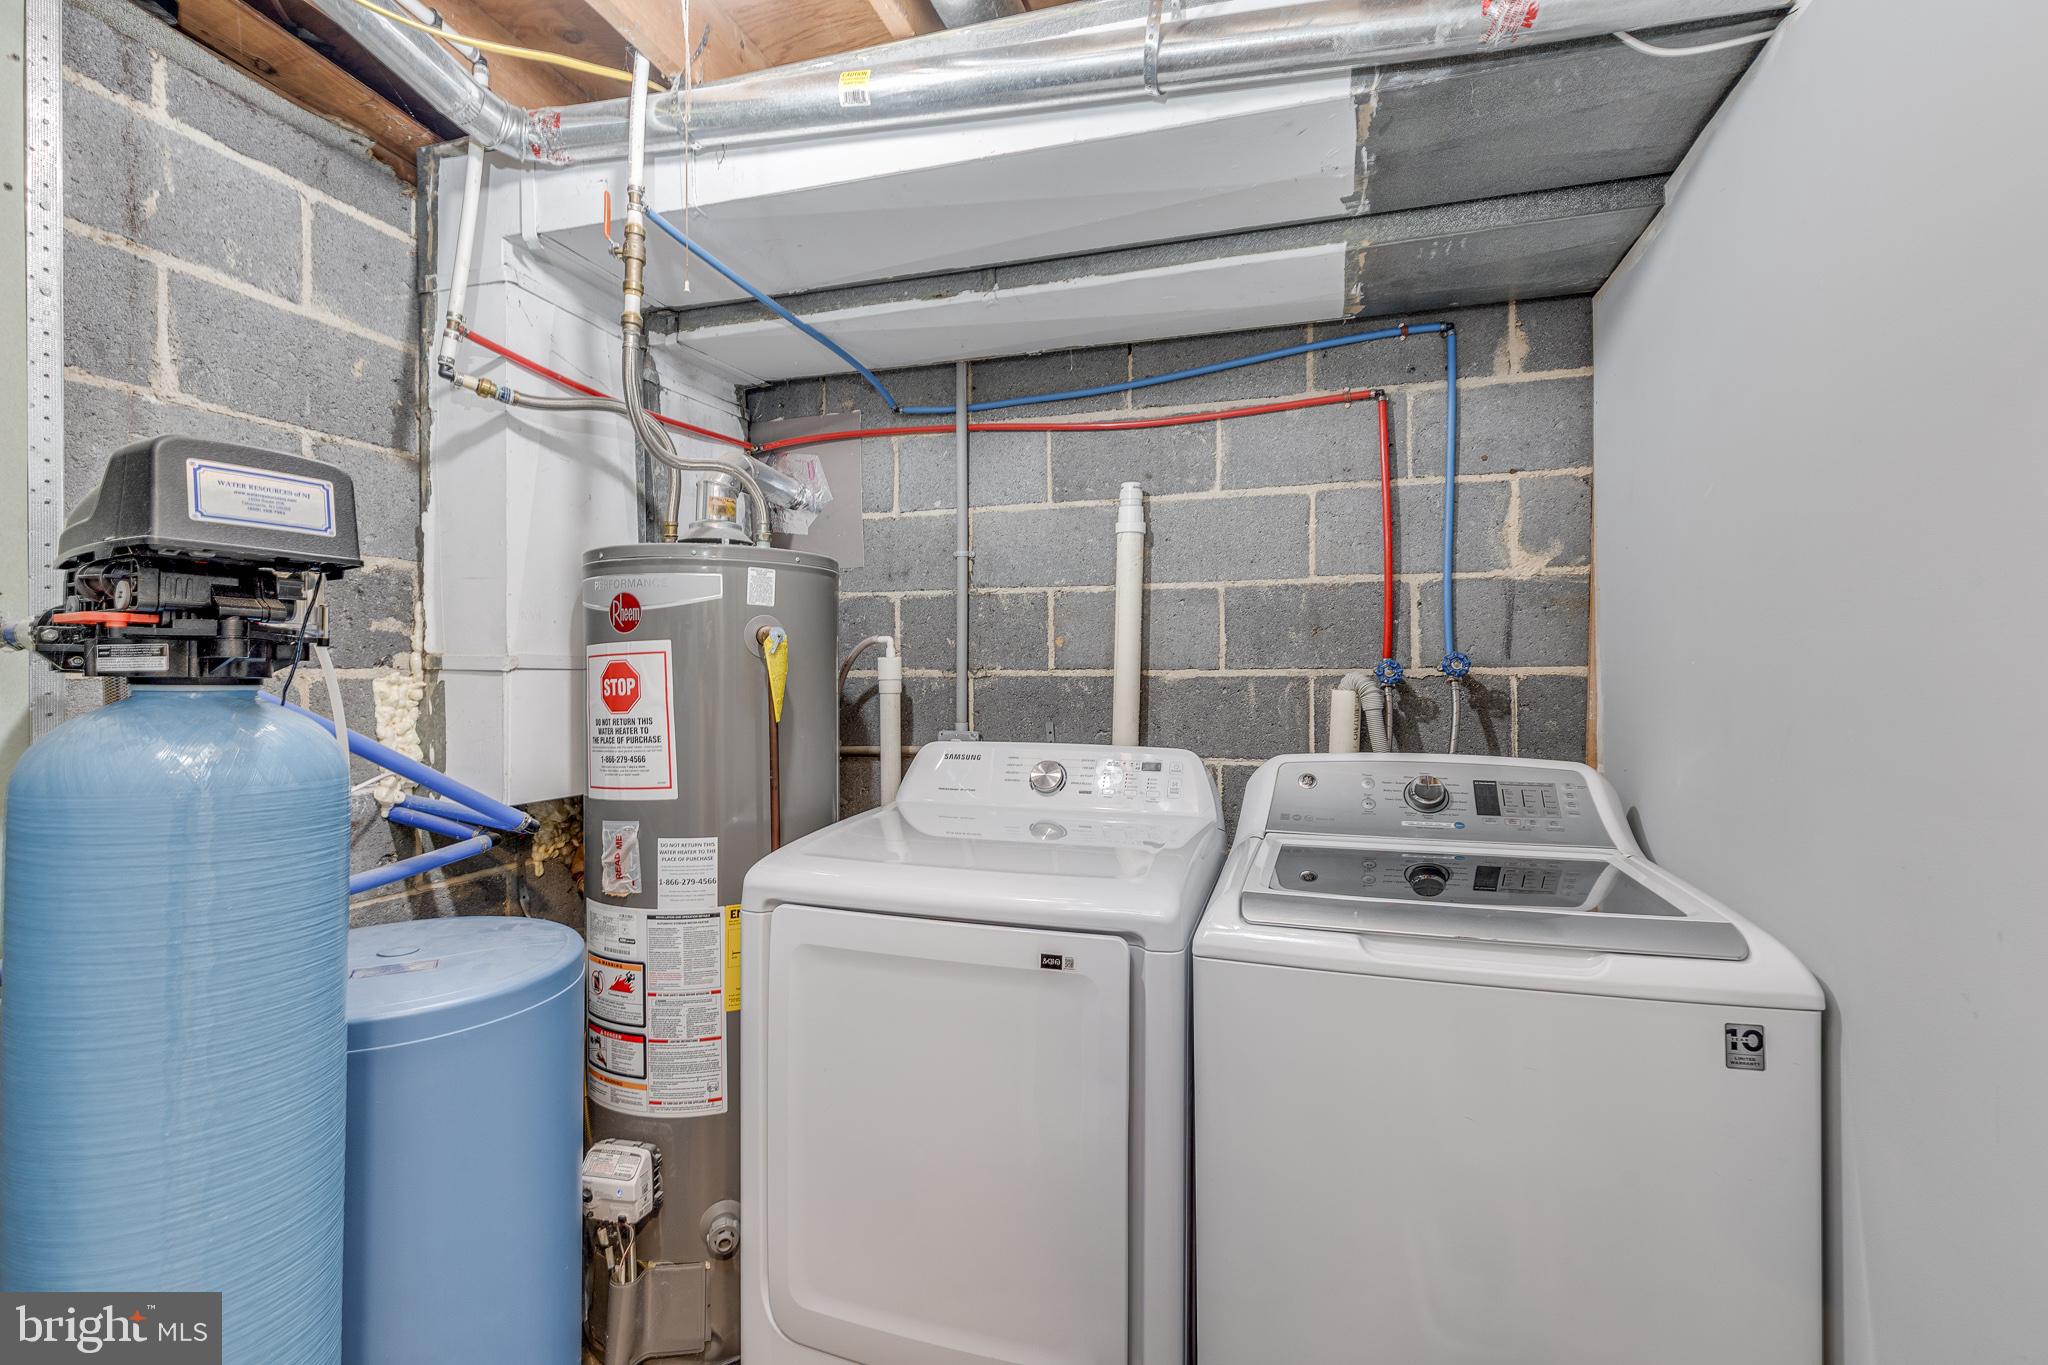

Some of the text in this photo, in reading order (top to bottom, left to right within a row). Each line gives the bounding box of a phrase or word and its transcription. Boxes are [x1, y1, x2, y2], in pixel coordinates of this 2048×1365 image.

[217, 480, 246, 489] WATER
[248, 484, 293, 496] RESOURCES
[594, 577, 668, 592] PERFORMANCE
[612, 594, 640, 627] Rheem
[603, 677, 636, 697] STOP
[595, 717, 653, 727] DO NOT RETURN THIS
[598, 726, 649, 735] WATER HEATER TO
[592, 735, 662, 744] THE PLACE OF PURCHASE
[600, 755, 646, 764] 1-866-279-4566
[944, 753, 982, 761] SAMSUNG
[614, 835, 623, 880] READ ME
[659, 878, 717, 886] 1-866-279-4566
[1726, 1029, 1763, 1052] 10
